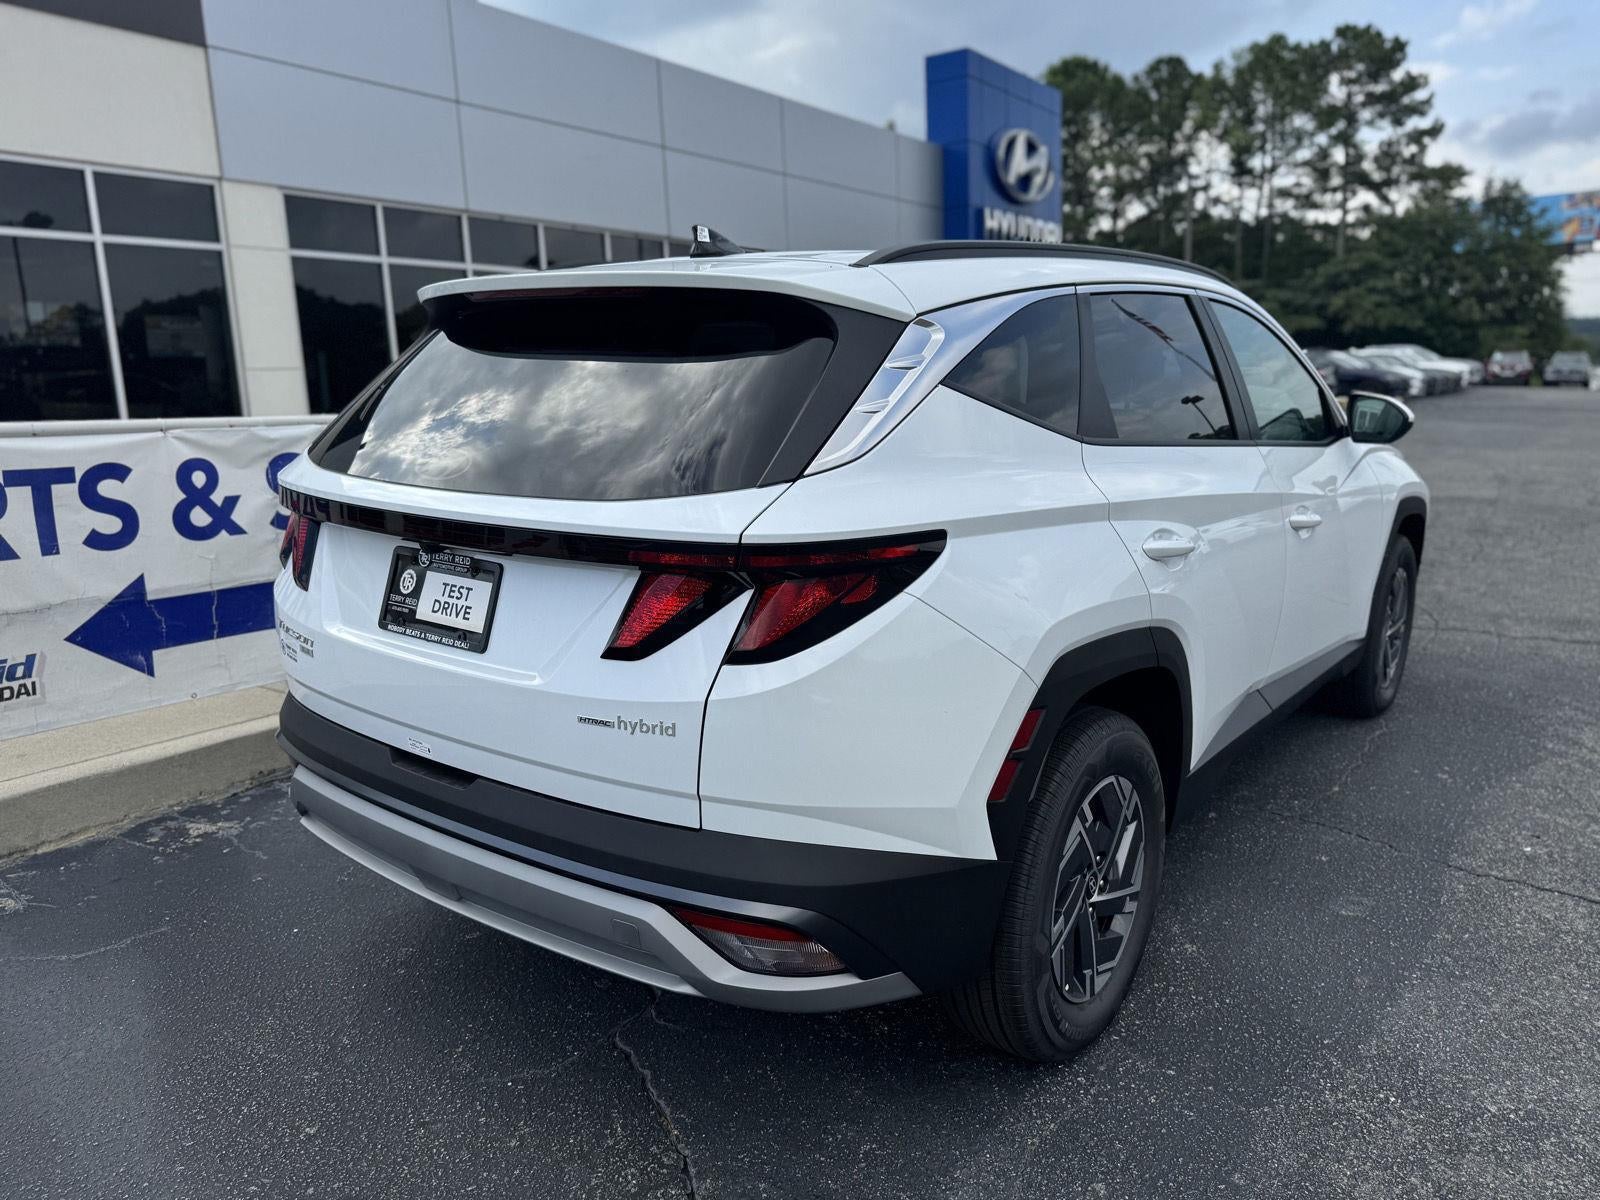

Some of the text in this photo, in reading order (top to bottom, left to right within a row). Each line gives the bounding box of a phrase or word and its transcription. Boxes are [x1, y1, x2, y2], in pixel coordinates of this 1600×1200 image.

[172, 457, 248, 541] &
[454, 555, 471, 565] REID
[389, 593, 417, 606] TERRY REID
[442, 582, 473, 602] TEST
[431, 598, 473, 621] DRIVE
[387, 624, 405, 633] NOBODY
[405, 628, 421, 637] BEATS
[425, 633, 442, 643] TERRY
[441, 637, 454, 646] REID
[454, 640, 470, 649] DEAL!
[578, 715, 677, 738] HTRAC hybrid
